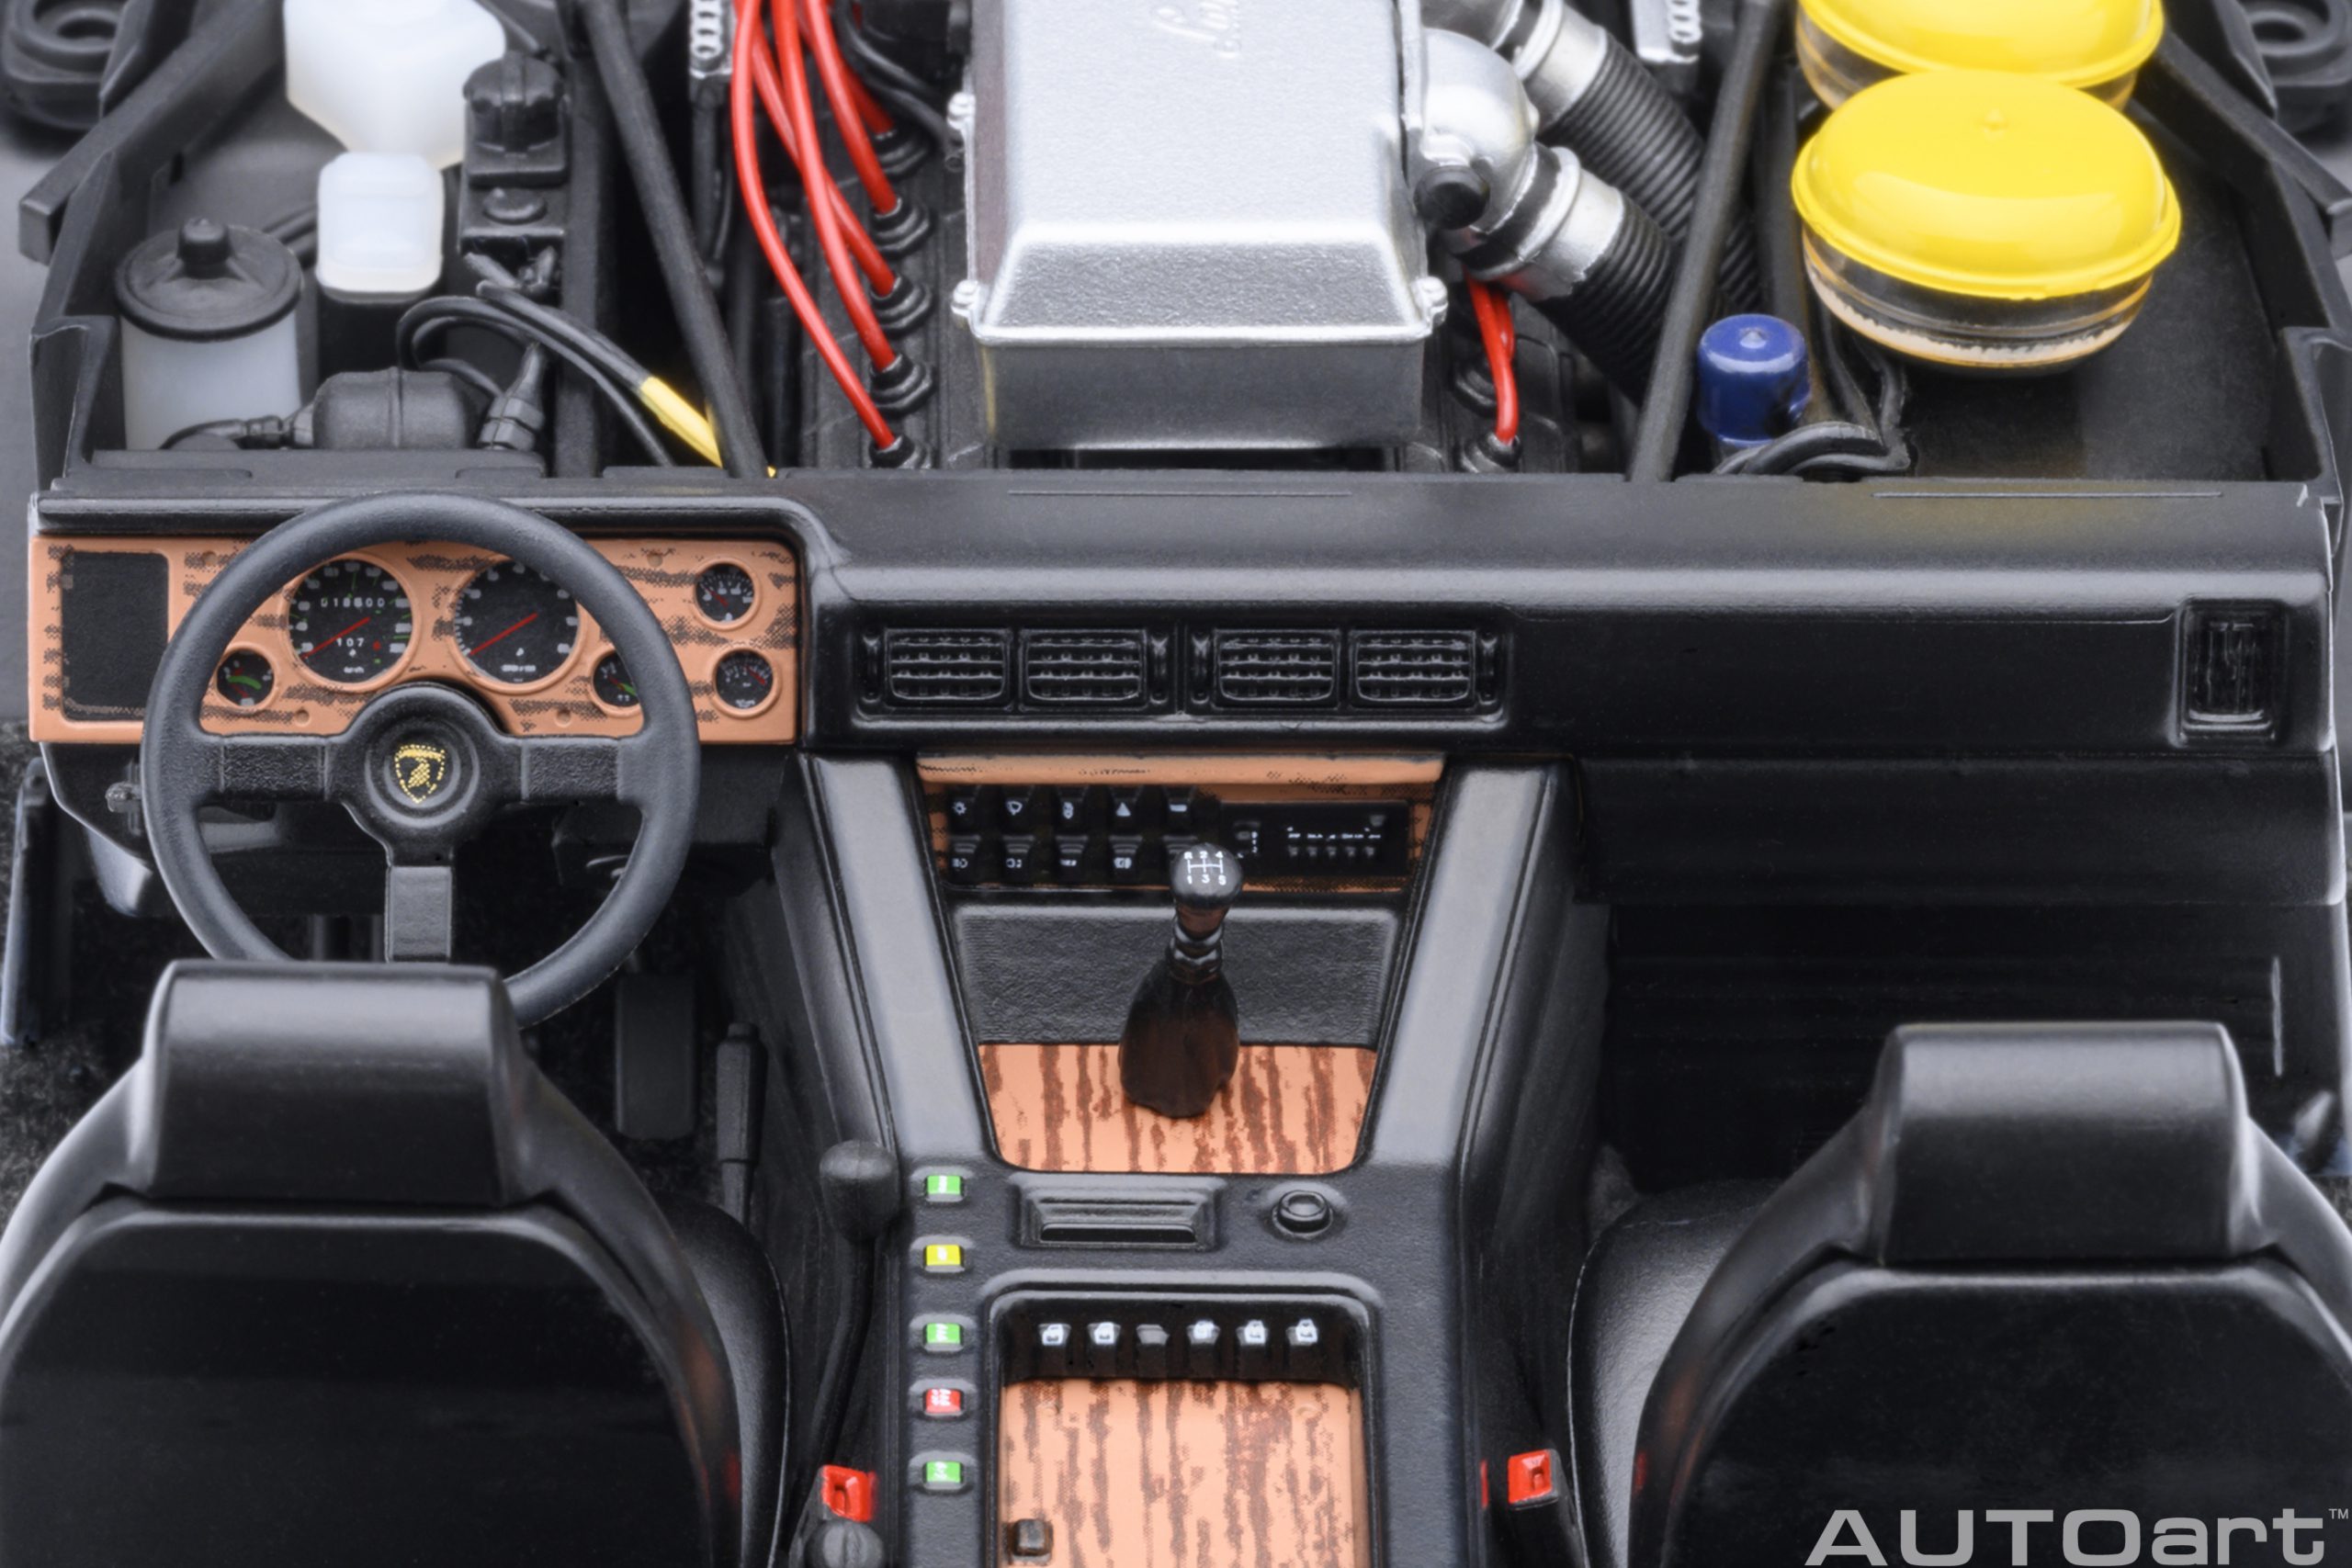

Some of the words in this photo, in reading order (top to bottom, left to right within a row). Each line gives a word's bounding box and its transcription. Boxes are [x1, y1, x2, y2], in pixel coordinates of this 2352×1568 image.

[336, 637, 365, 648] 107
[1215, 851, 1224, 859] 4
[1187, 874, 1193, 885] 1
[1202, 874, 1210, 884] 3
